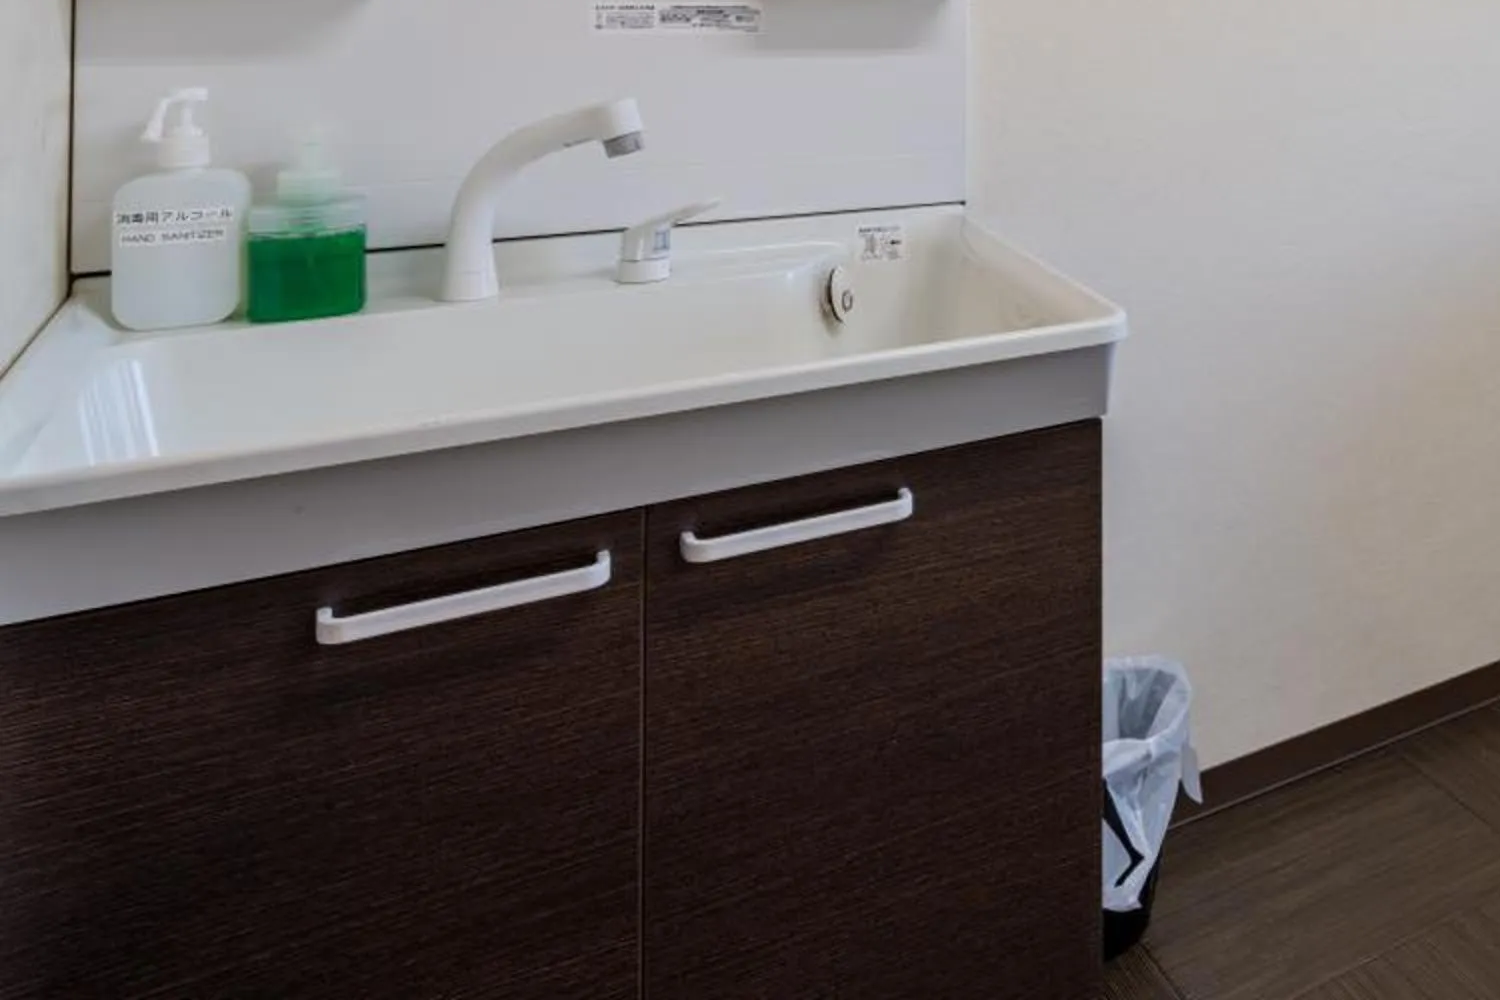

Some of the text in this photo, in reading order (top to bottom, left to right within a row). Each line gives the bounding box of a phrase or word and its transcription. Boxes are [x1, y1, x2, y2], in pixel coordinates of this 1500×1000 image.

[117, 208, 233, 225] 消毒用アルコール
